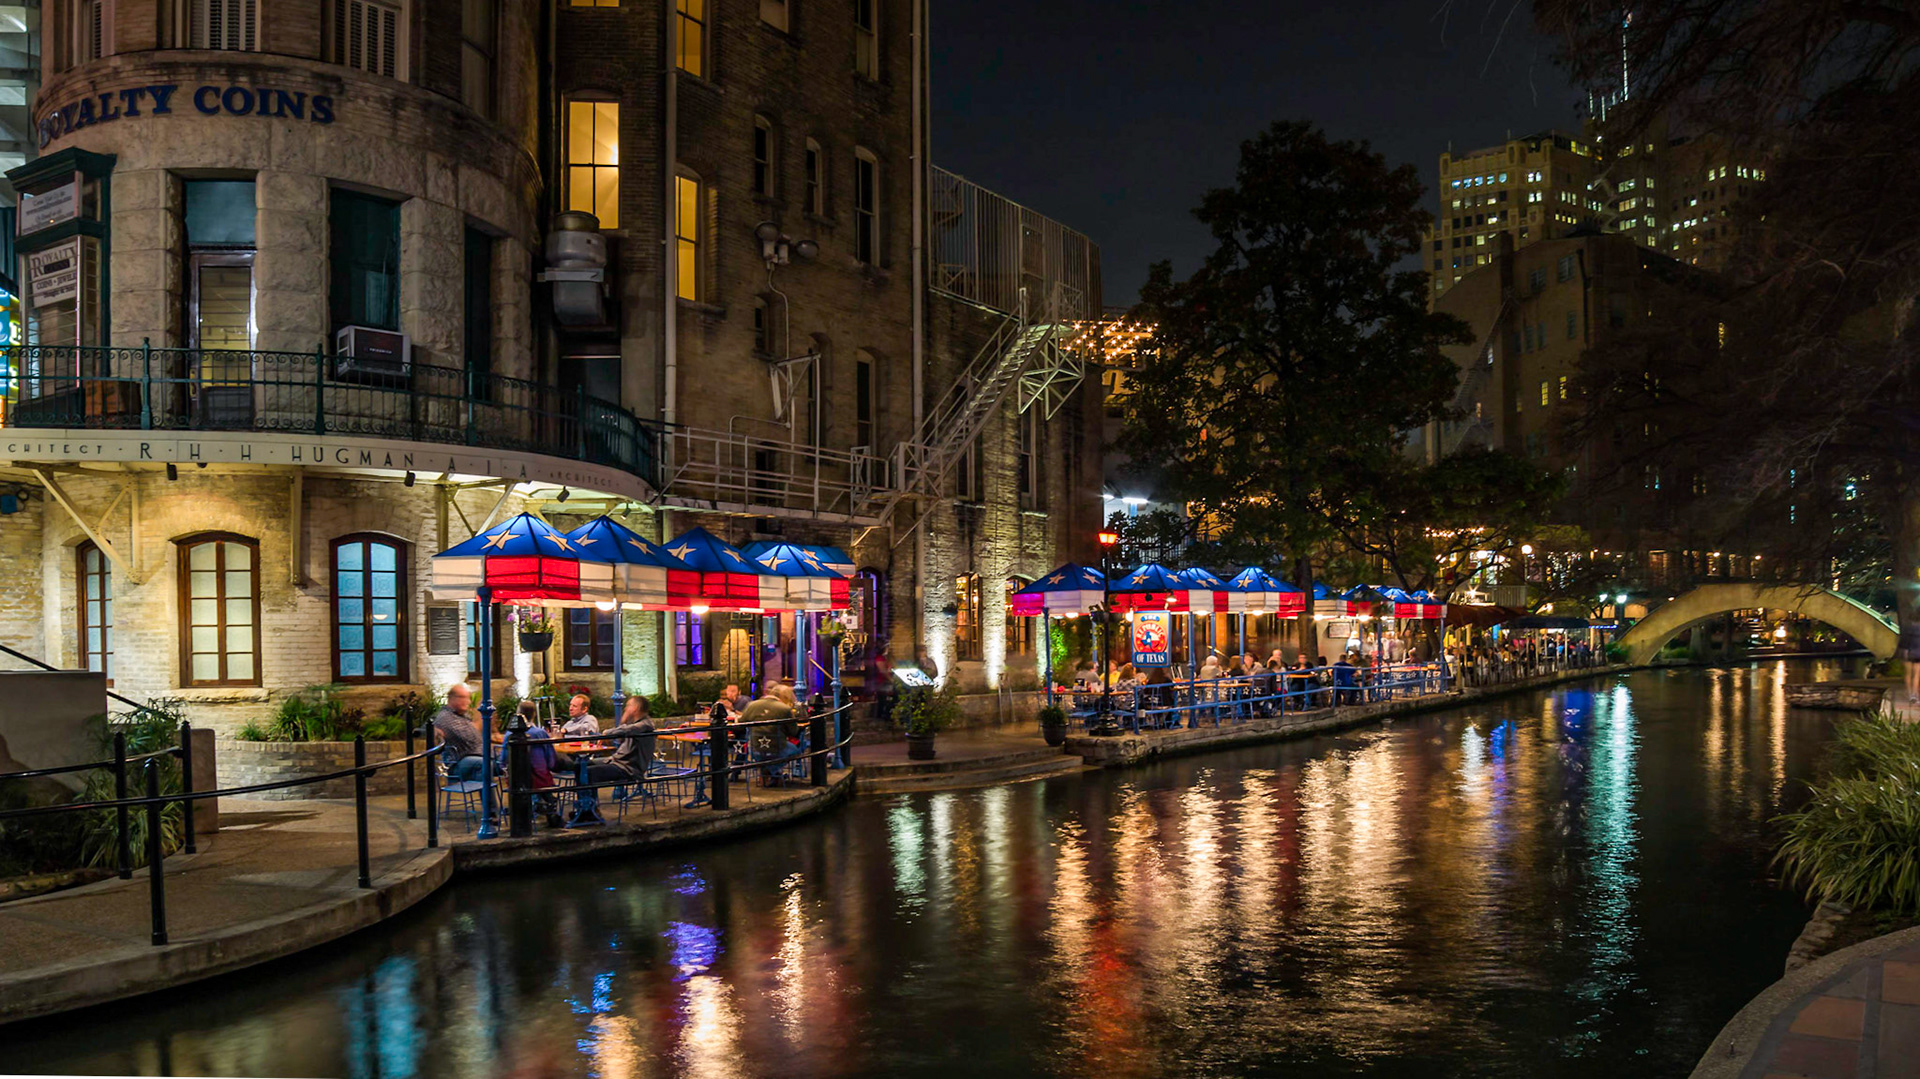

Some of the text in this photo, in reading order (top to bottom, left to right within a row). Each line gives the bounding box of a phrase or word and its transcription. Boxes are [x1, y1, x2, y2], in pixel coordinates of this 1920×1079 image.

[193, 85, 336, 124] COINS
[31, 246, 77, 279] ROYALTY
[7, 443, 103, 454] CHITECT
[139, 442, 153, 460] R
[291, 445, 414, 468] HUGMAN
[549, 471, 612, 485] ARCHITECT
[1136, 622, 1165, 638] REPUBLIC
[1136, 653, 1165, 663] OF TEXAS
